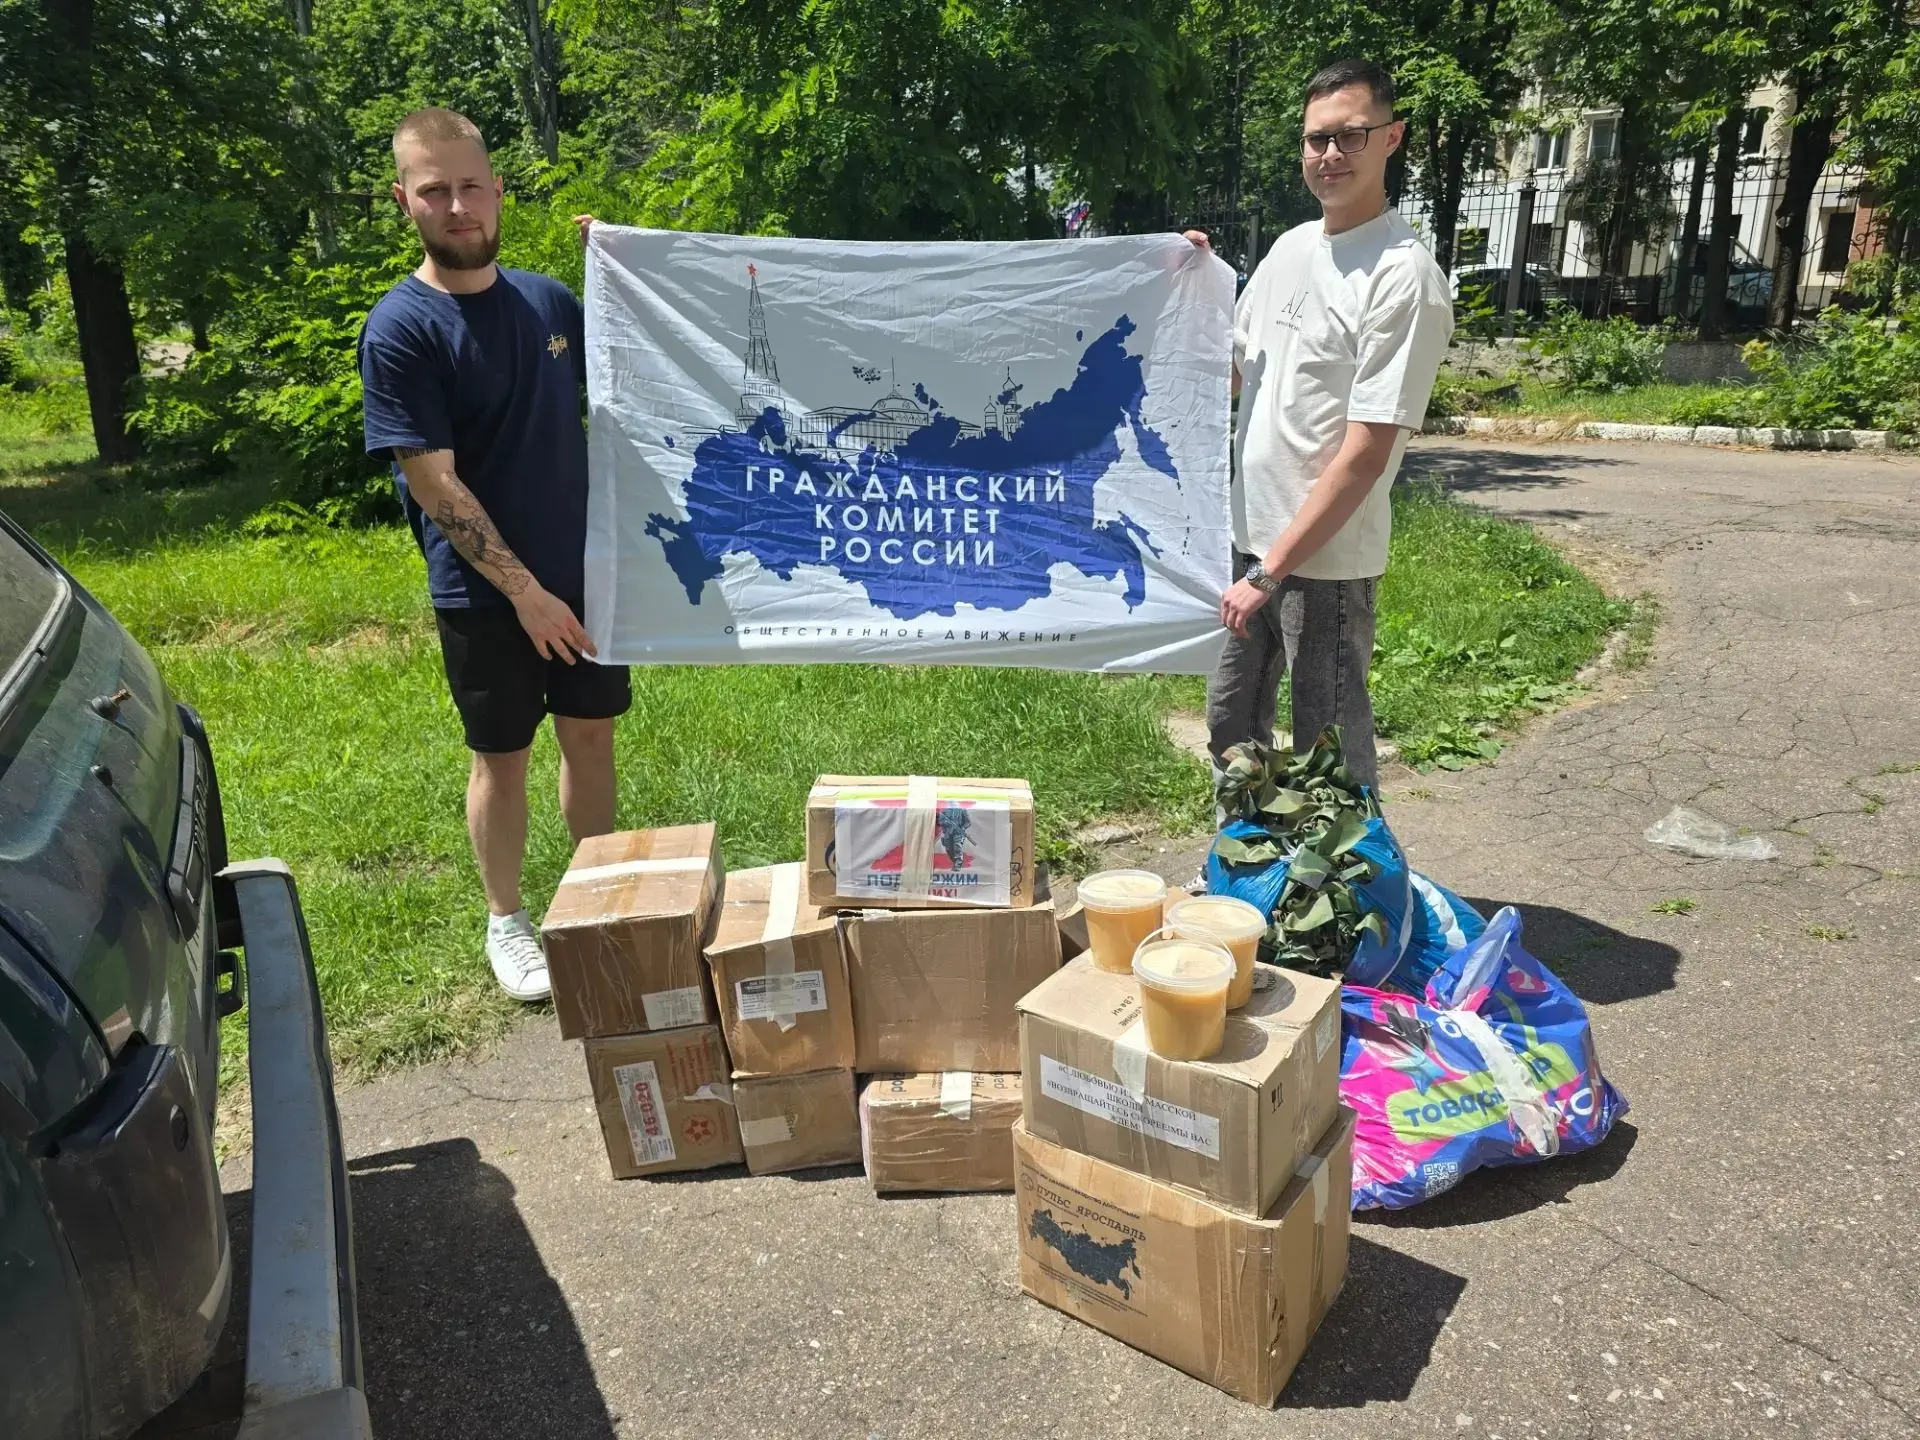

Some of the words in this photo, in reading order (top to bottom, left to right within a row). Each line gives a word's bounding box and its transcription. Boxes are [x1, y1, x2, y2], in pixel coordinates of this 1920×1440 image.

[745, 466, 1066, 503] ГРАЖДАНСКИЙ
[815, 503, 1000, 534] КОМИТЕТ
[820, 536, 995, 566] РОССИИ
[724, 625, 924, 639] ОБЩЕСТВЕННОЕ
[944, 630, 1077, 643] ДВИЖЕНИЕ
[1190, 1132, 1213, 1147] ВАС
[1036, 1184, 1072, 1209] ПУЛЬС
[1075, 1204, 1147, 1242] ЯРОСЛАВЛЬ
